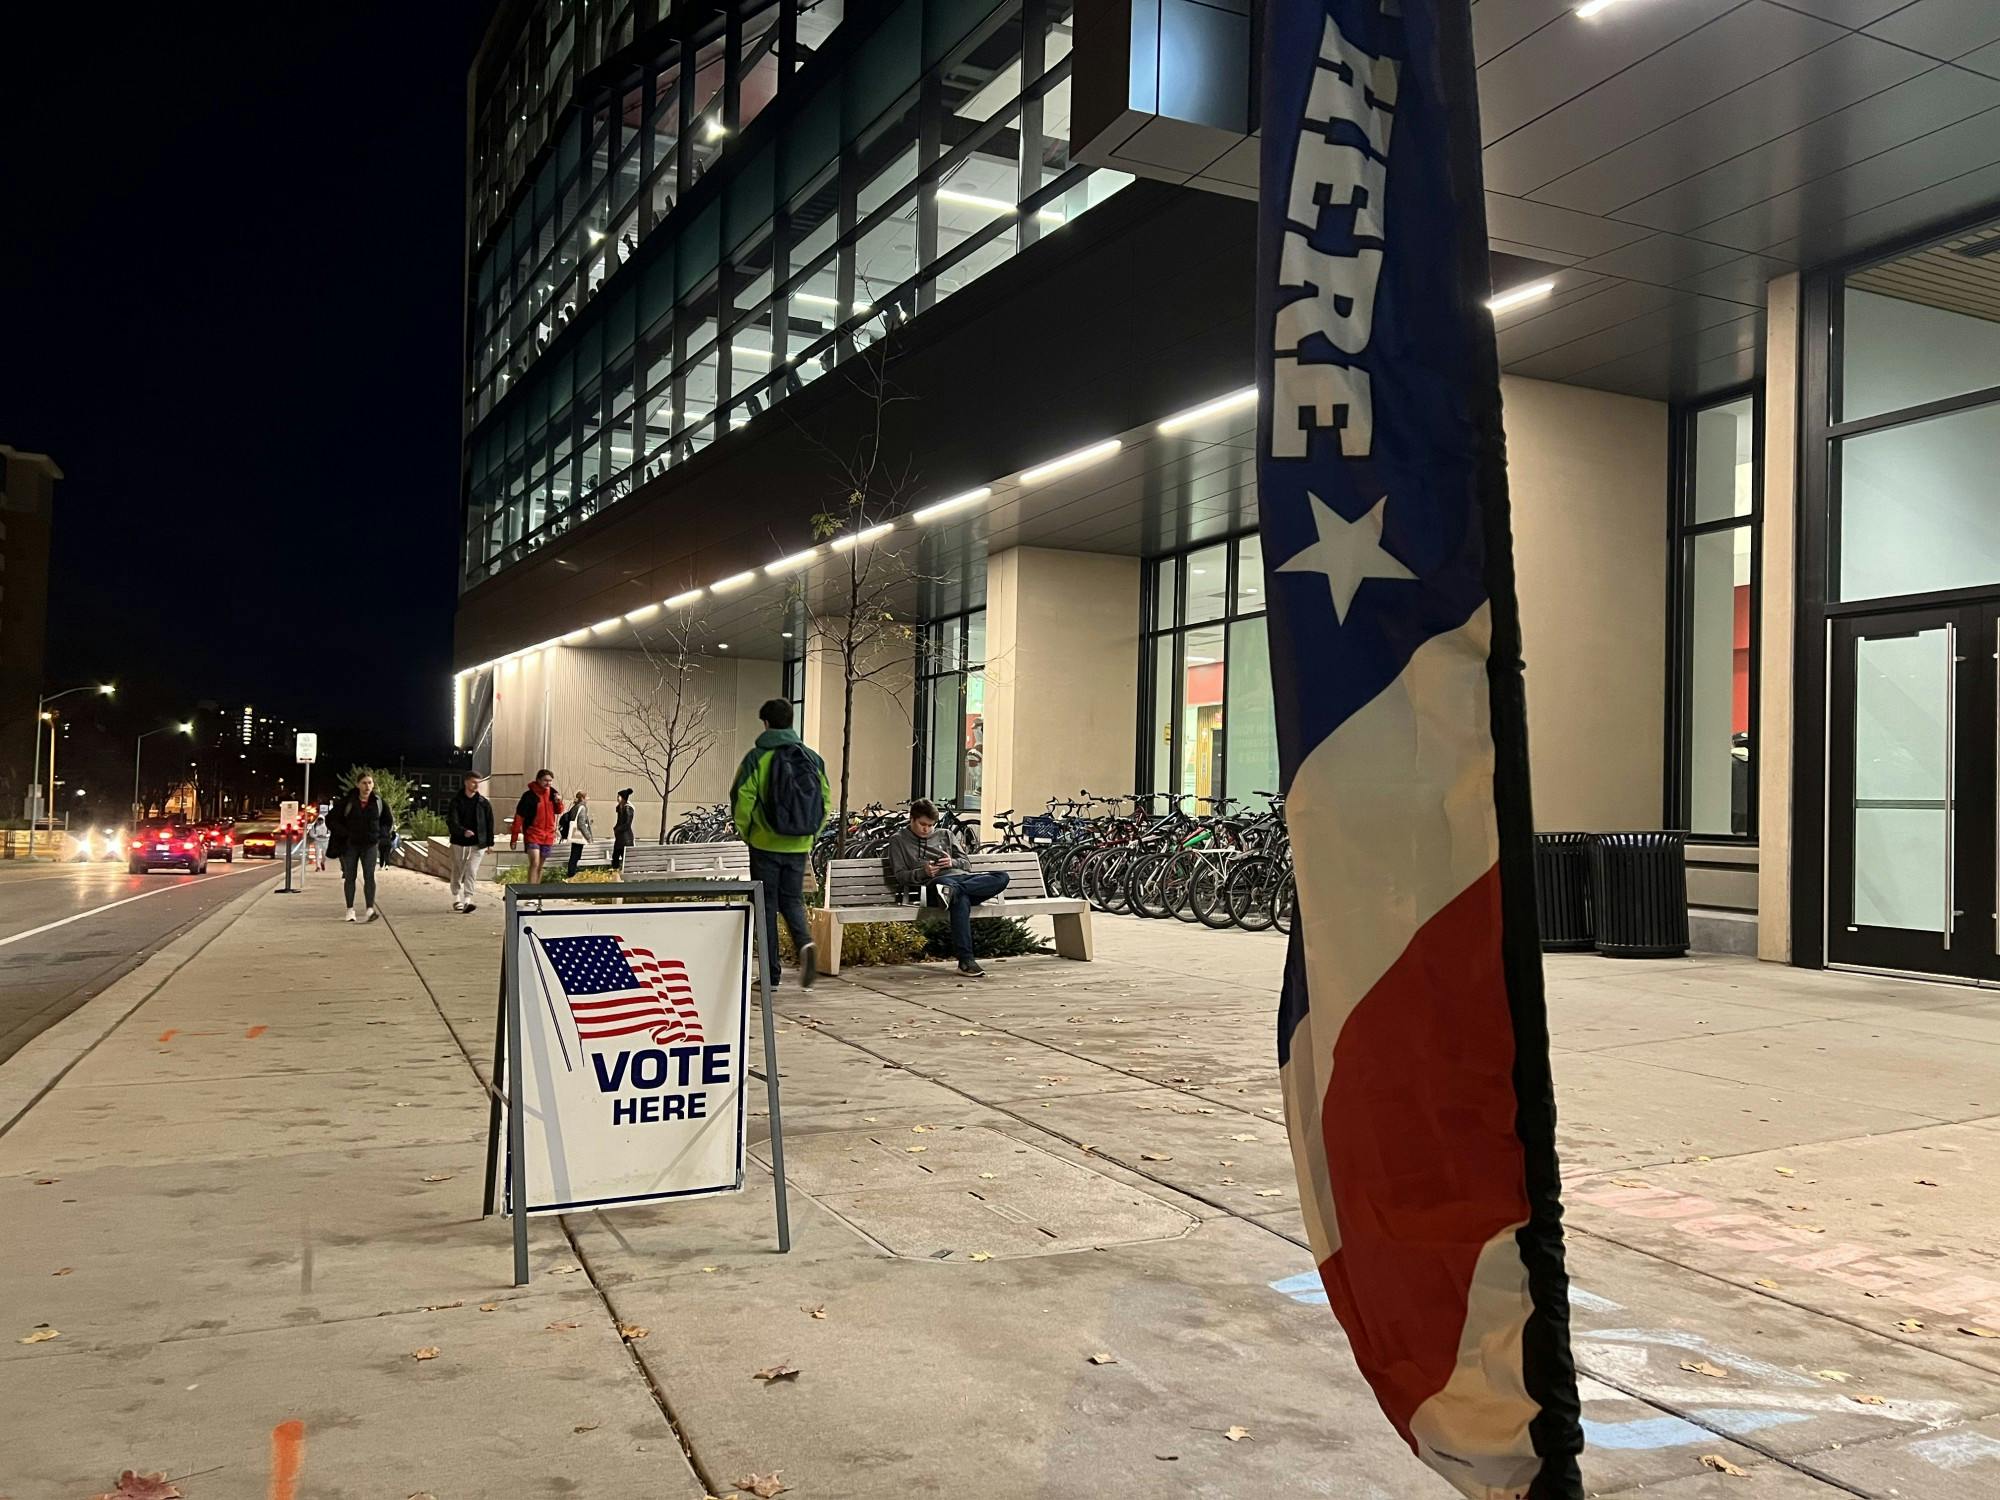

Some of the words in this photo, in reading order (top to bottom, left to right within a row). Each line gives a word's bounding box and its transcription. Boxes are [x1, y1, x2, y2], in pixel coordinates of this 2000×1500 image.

[1273, 14, 1400, 458] HERE
[591, 1044, 731, 1092] VOTE
[613, 1093, 707, 1126] HERE
